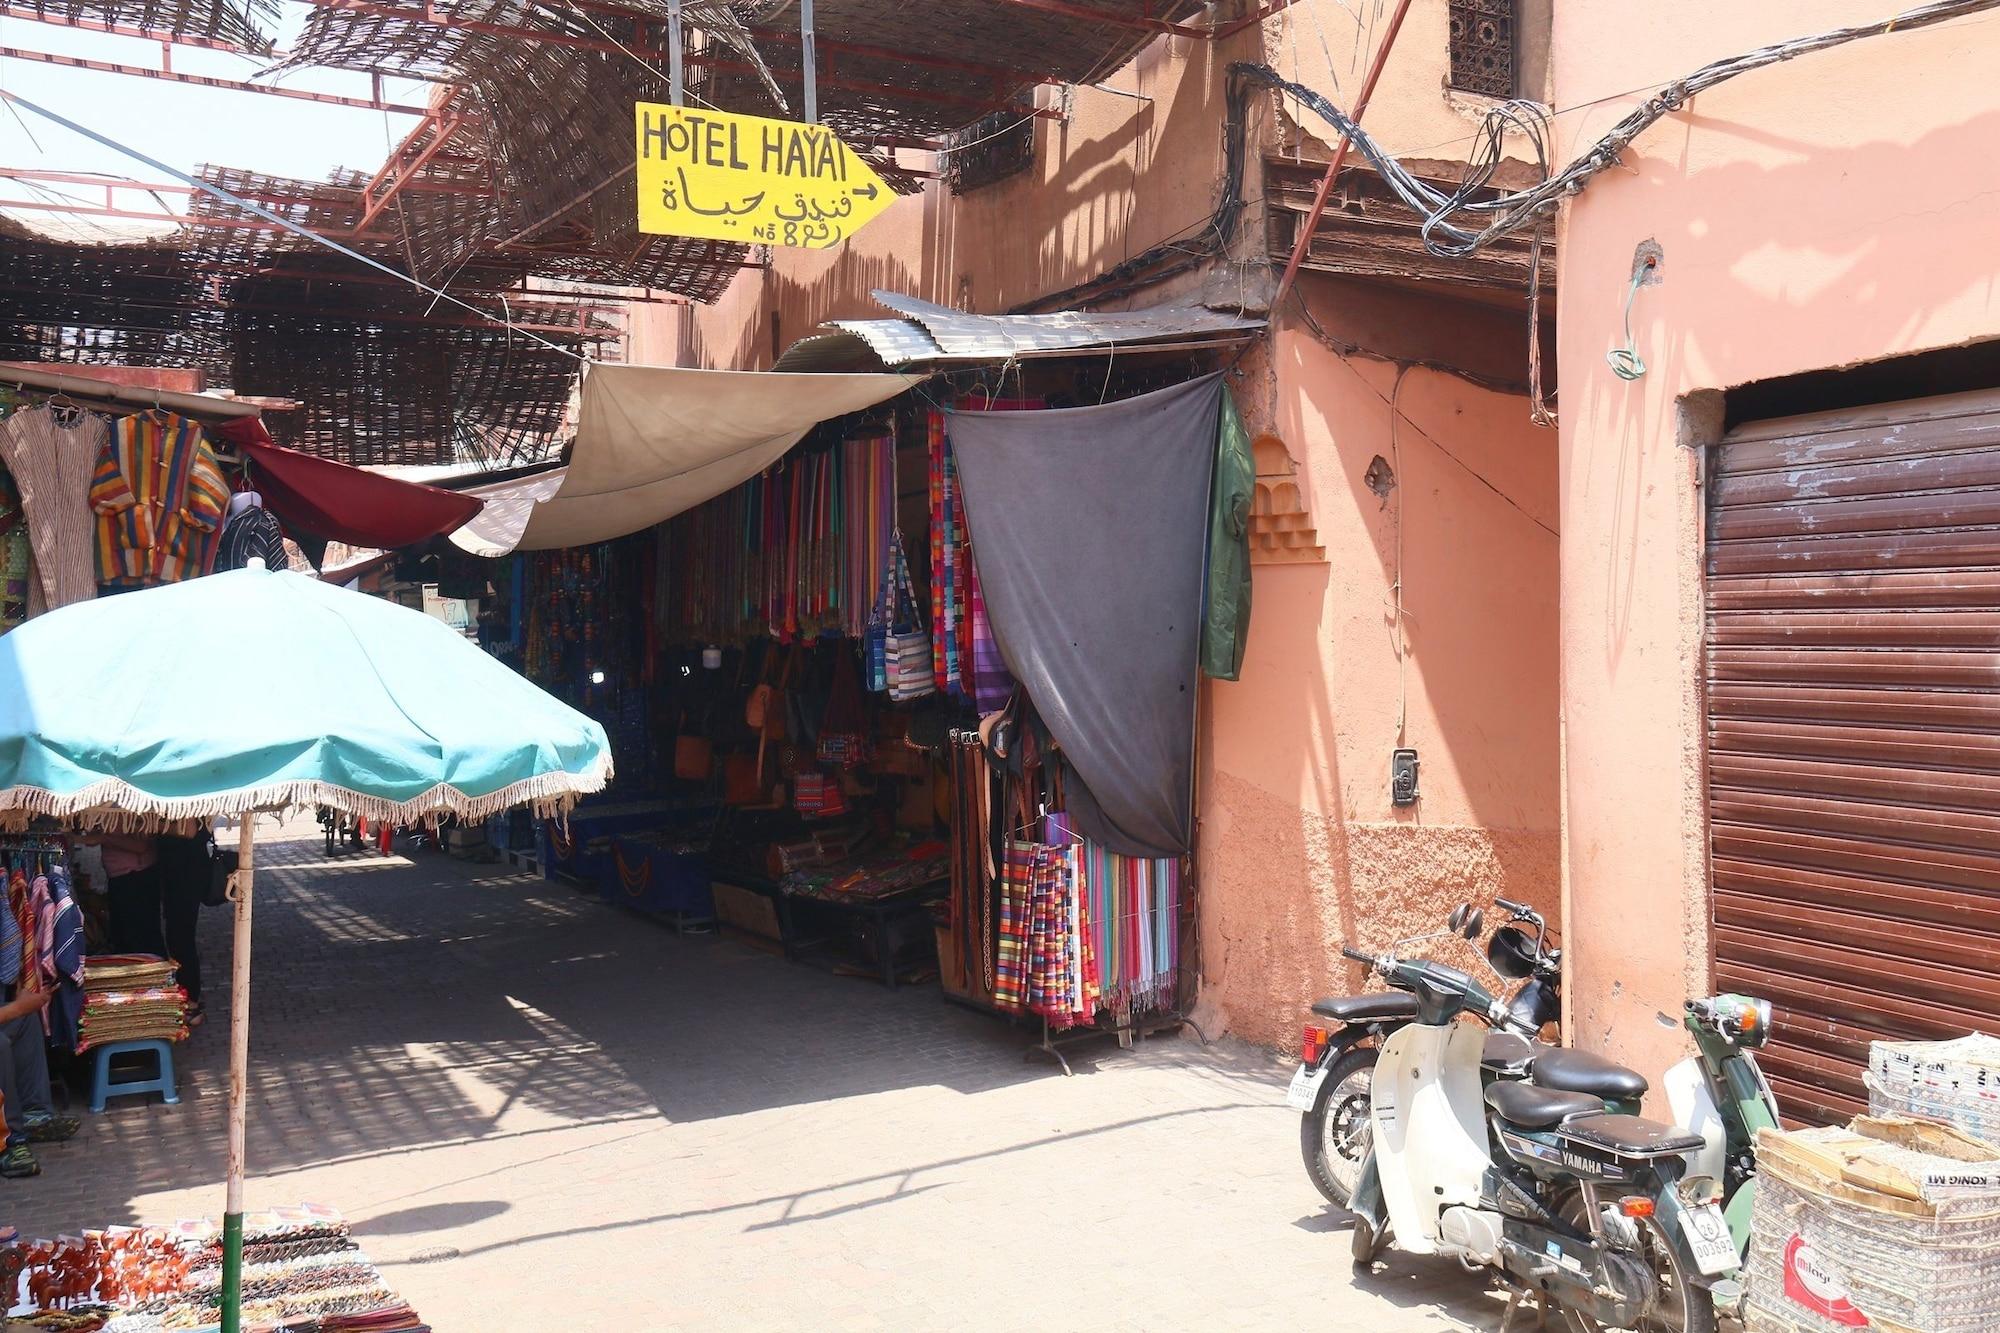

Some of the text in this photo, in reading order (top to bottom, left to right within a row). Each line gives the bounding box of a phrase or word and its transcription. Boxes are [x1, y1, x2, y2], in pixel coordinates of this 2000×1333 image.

[644, 111, 749, 170] HOTEL
[661, 166, 852, 227] فندق حياة
[784, 221, 798, 248] 8
[1562, 1151, 1602, 1175] YAMAHA
[1700, 1223, 1714, 1237] 26
[1696, 1239, 1734, 1258] 003892
